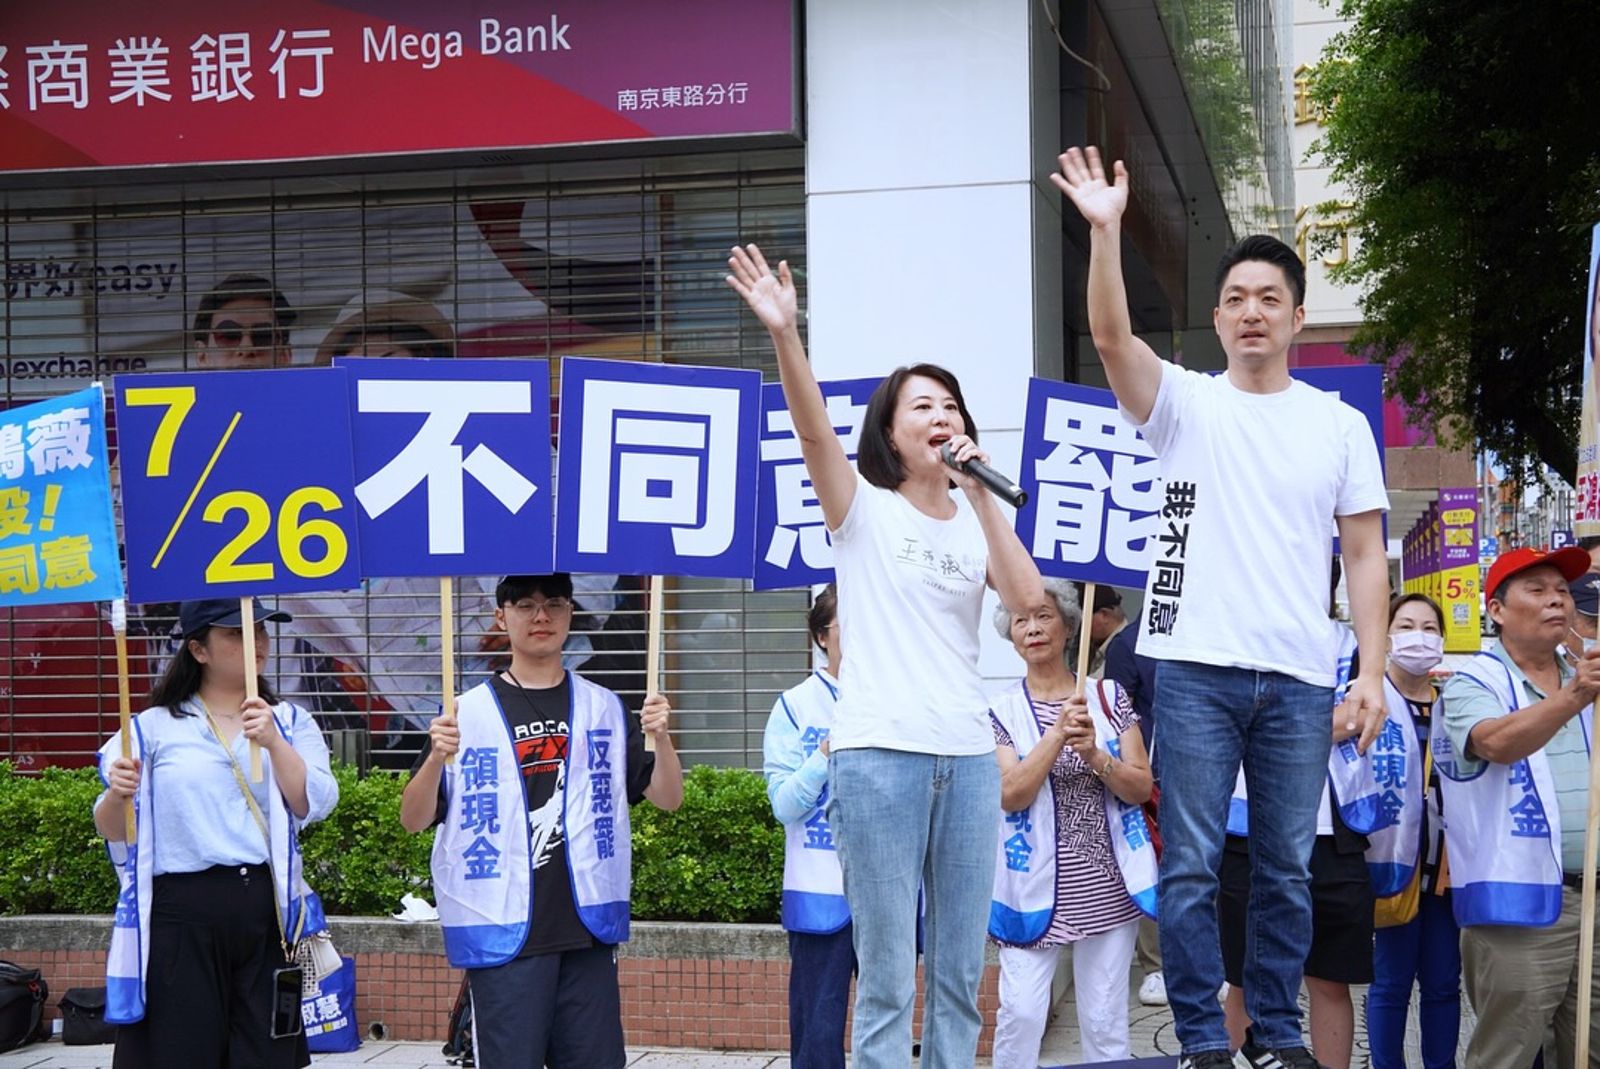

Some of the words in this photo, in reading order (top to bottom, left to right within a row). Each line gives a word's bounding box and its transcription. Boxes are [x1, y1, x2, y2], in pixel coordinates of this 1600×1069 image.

[0, 28, 334, 112] 商業銀行
[362, 25, 463, 69] Mega
[479, 14, 572, 56] Bank
[617, 82, 749, 111] 南京東路分行
[125, 386, 349, 584] 7/26
[1148, 480, 1197, 637] 我不同意
[459, 746, 502, 881] 領現金
